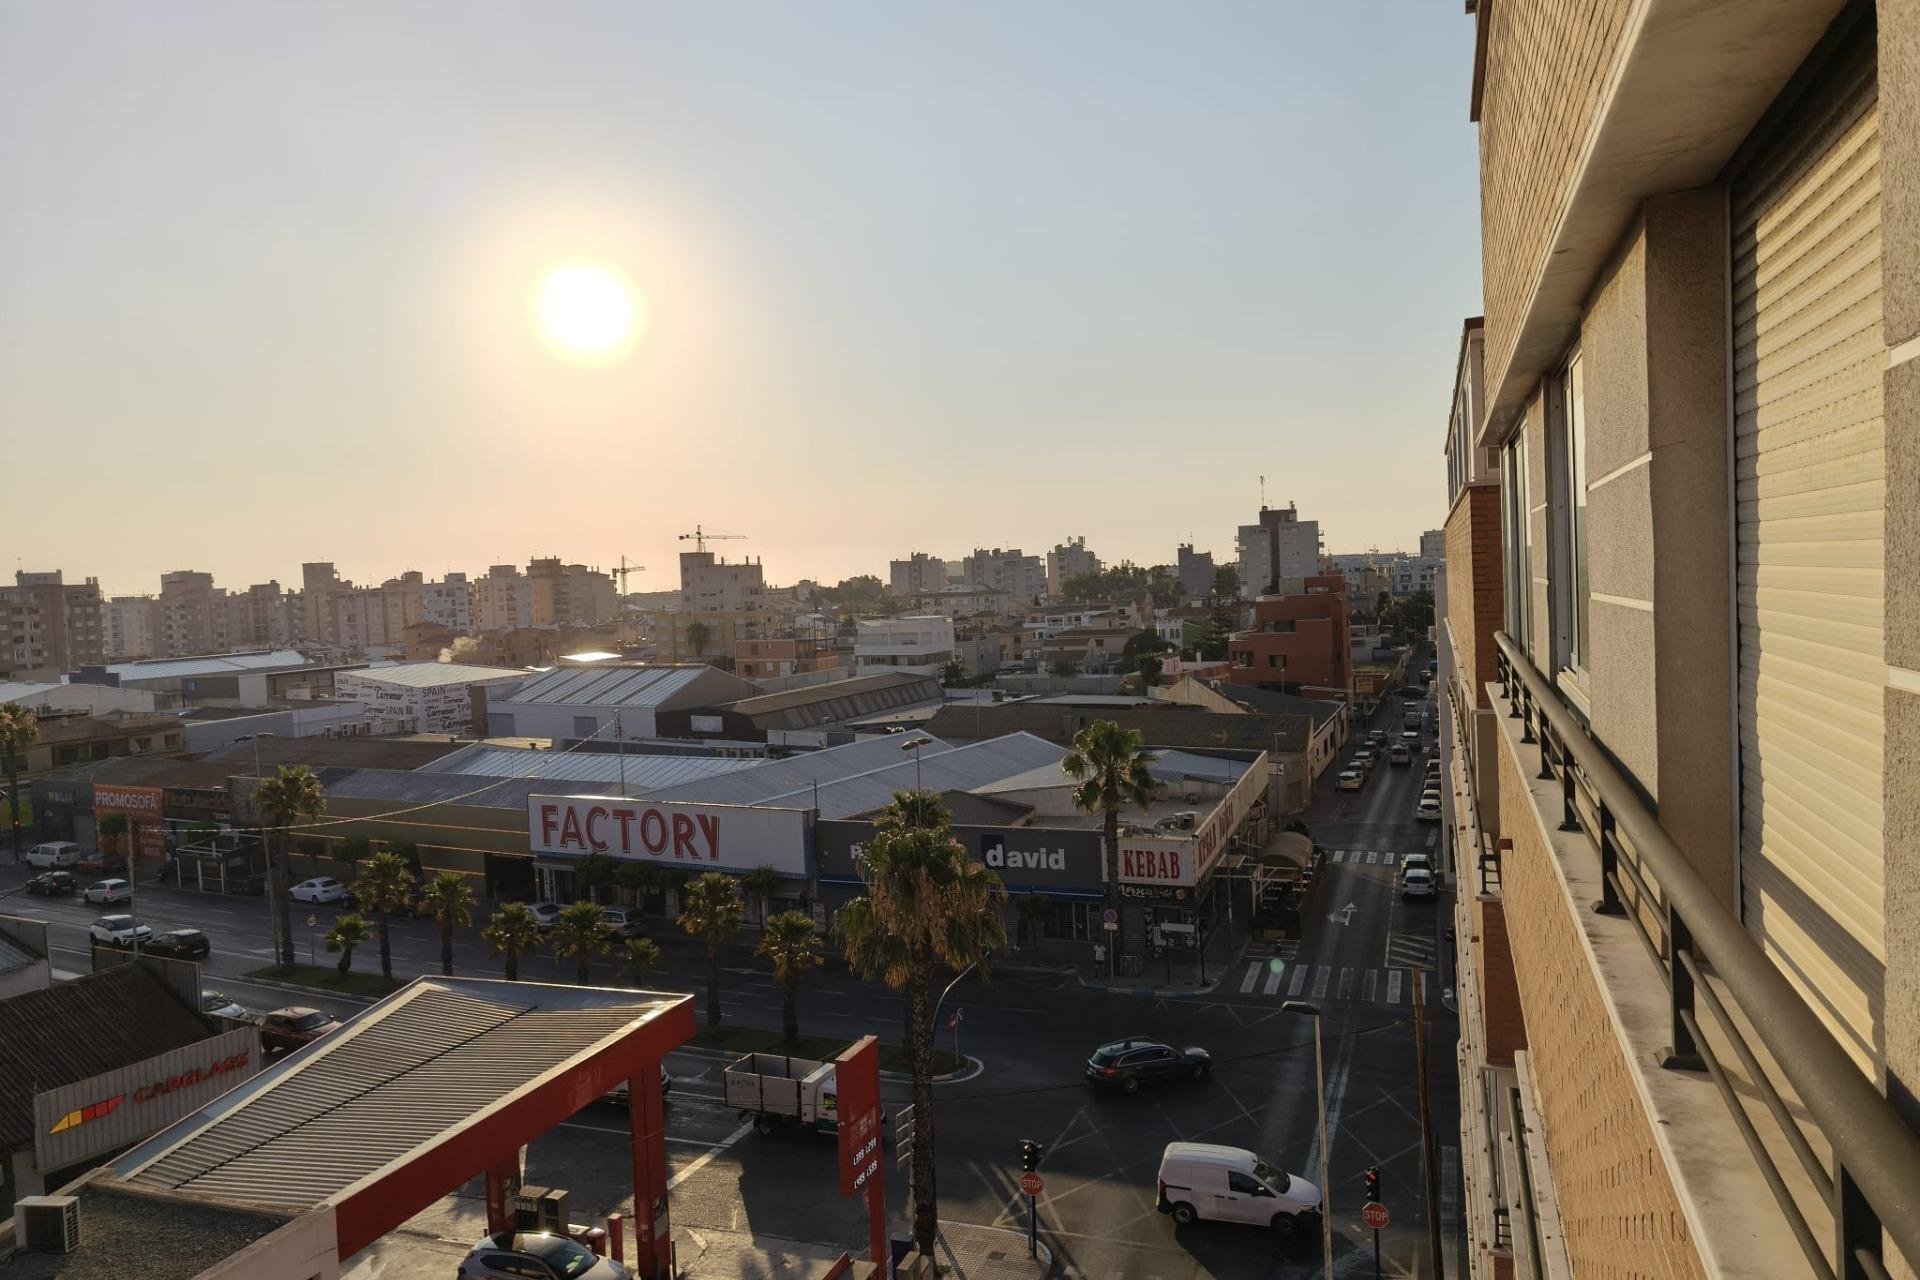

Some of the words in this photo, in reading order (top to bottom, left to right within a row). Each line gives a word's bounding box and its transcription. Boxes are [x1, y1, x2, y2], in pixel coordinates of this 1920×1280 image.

[422, 687, 446, 698] SPAIN
[541, 804, 720, 861] FACTORY
[985, 843, 1066, 870] david
[1123, 849, 1181, 880] KEBAB
[1022, 1179, 1041, 1189] STOP
[1364, 1210, 1387, 1221] STOP
